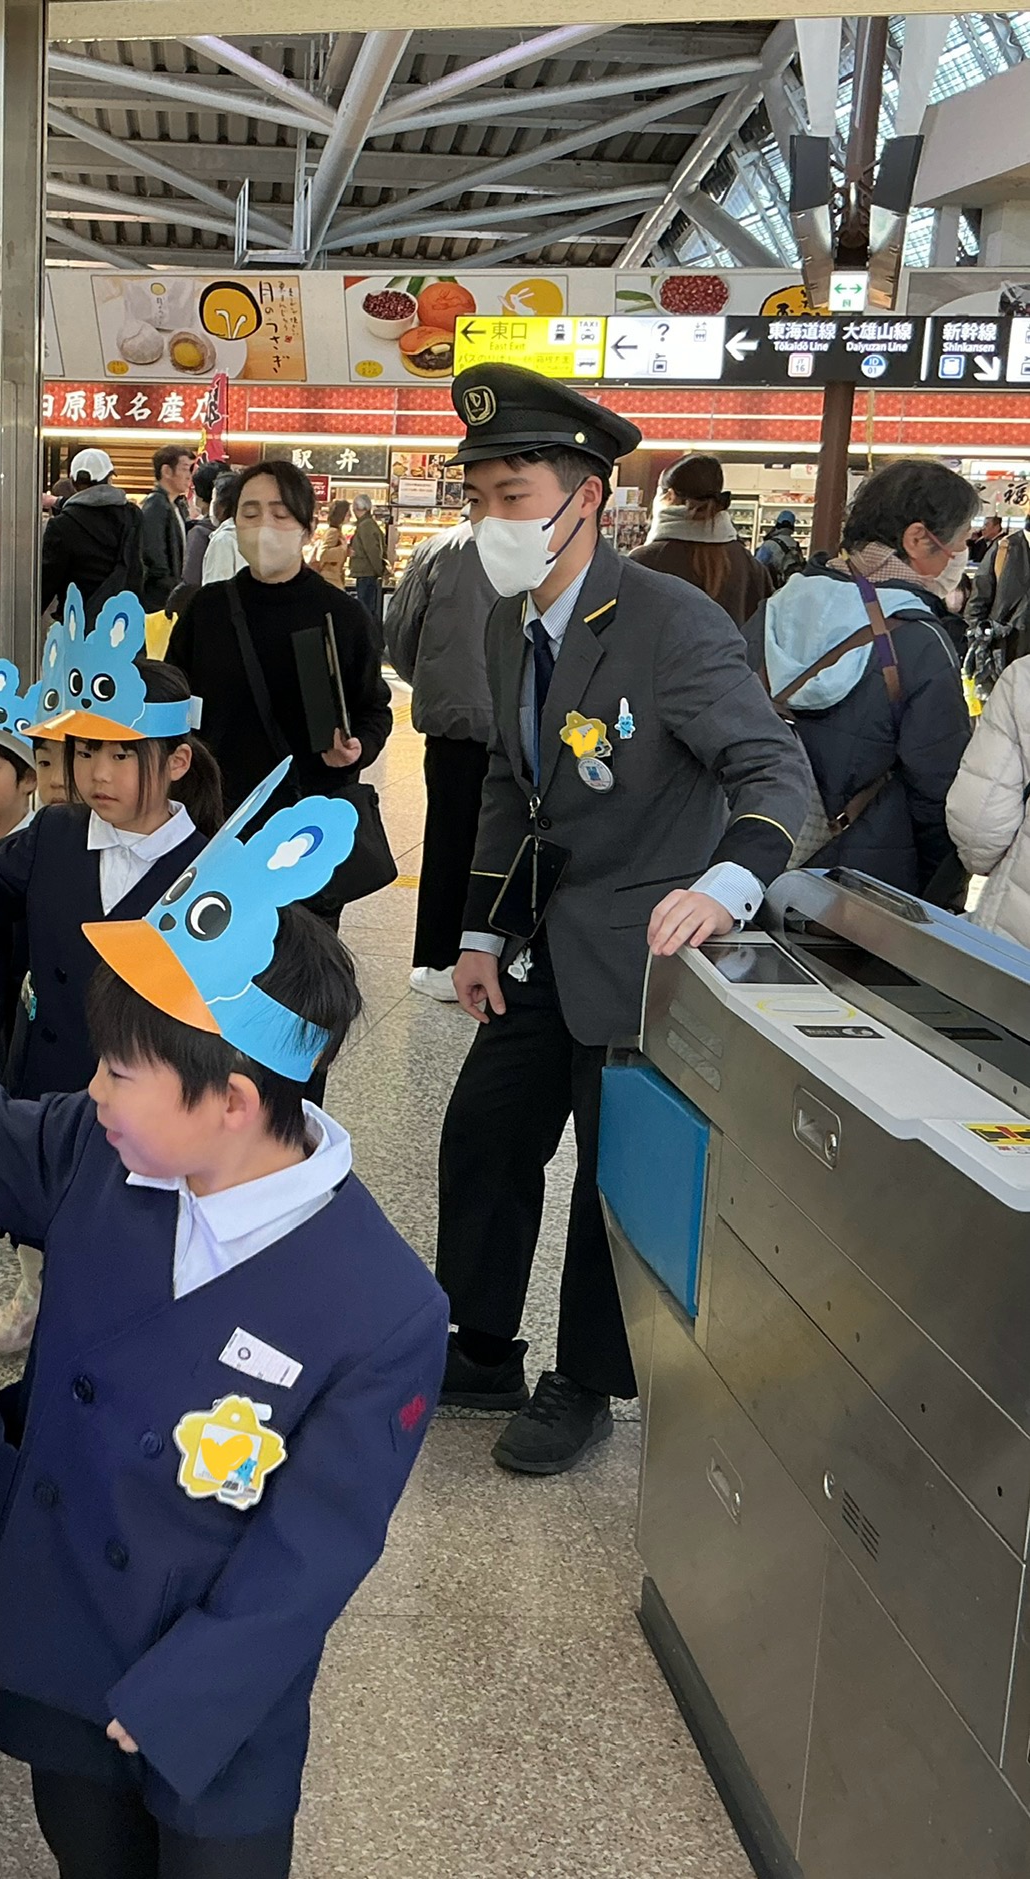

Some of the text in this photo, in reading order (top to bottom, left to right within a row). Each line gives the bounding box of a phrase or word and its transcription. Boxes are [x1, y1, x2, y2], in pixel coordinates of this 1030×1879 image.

[491, 321, 527, 340] 東口
[768, 322, 836, 340] 東海道線
[842, 322, 912, 340] 大雄山線
[942, 322, 997, 341] 新幹線
[489, 342, 525, 351] East Exit
[810, 341, 829, 351] Line
[846, 342, 908, 353] Daiyuzan Line
[942, 342, 995, 352] Shinkansen
[795, 364, 806, 372] 16
[868, 366, 877, 374] 01
[291, 448, 360, 473] 駅弁
